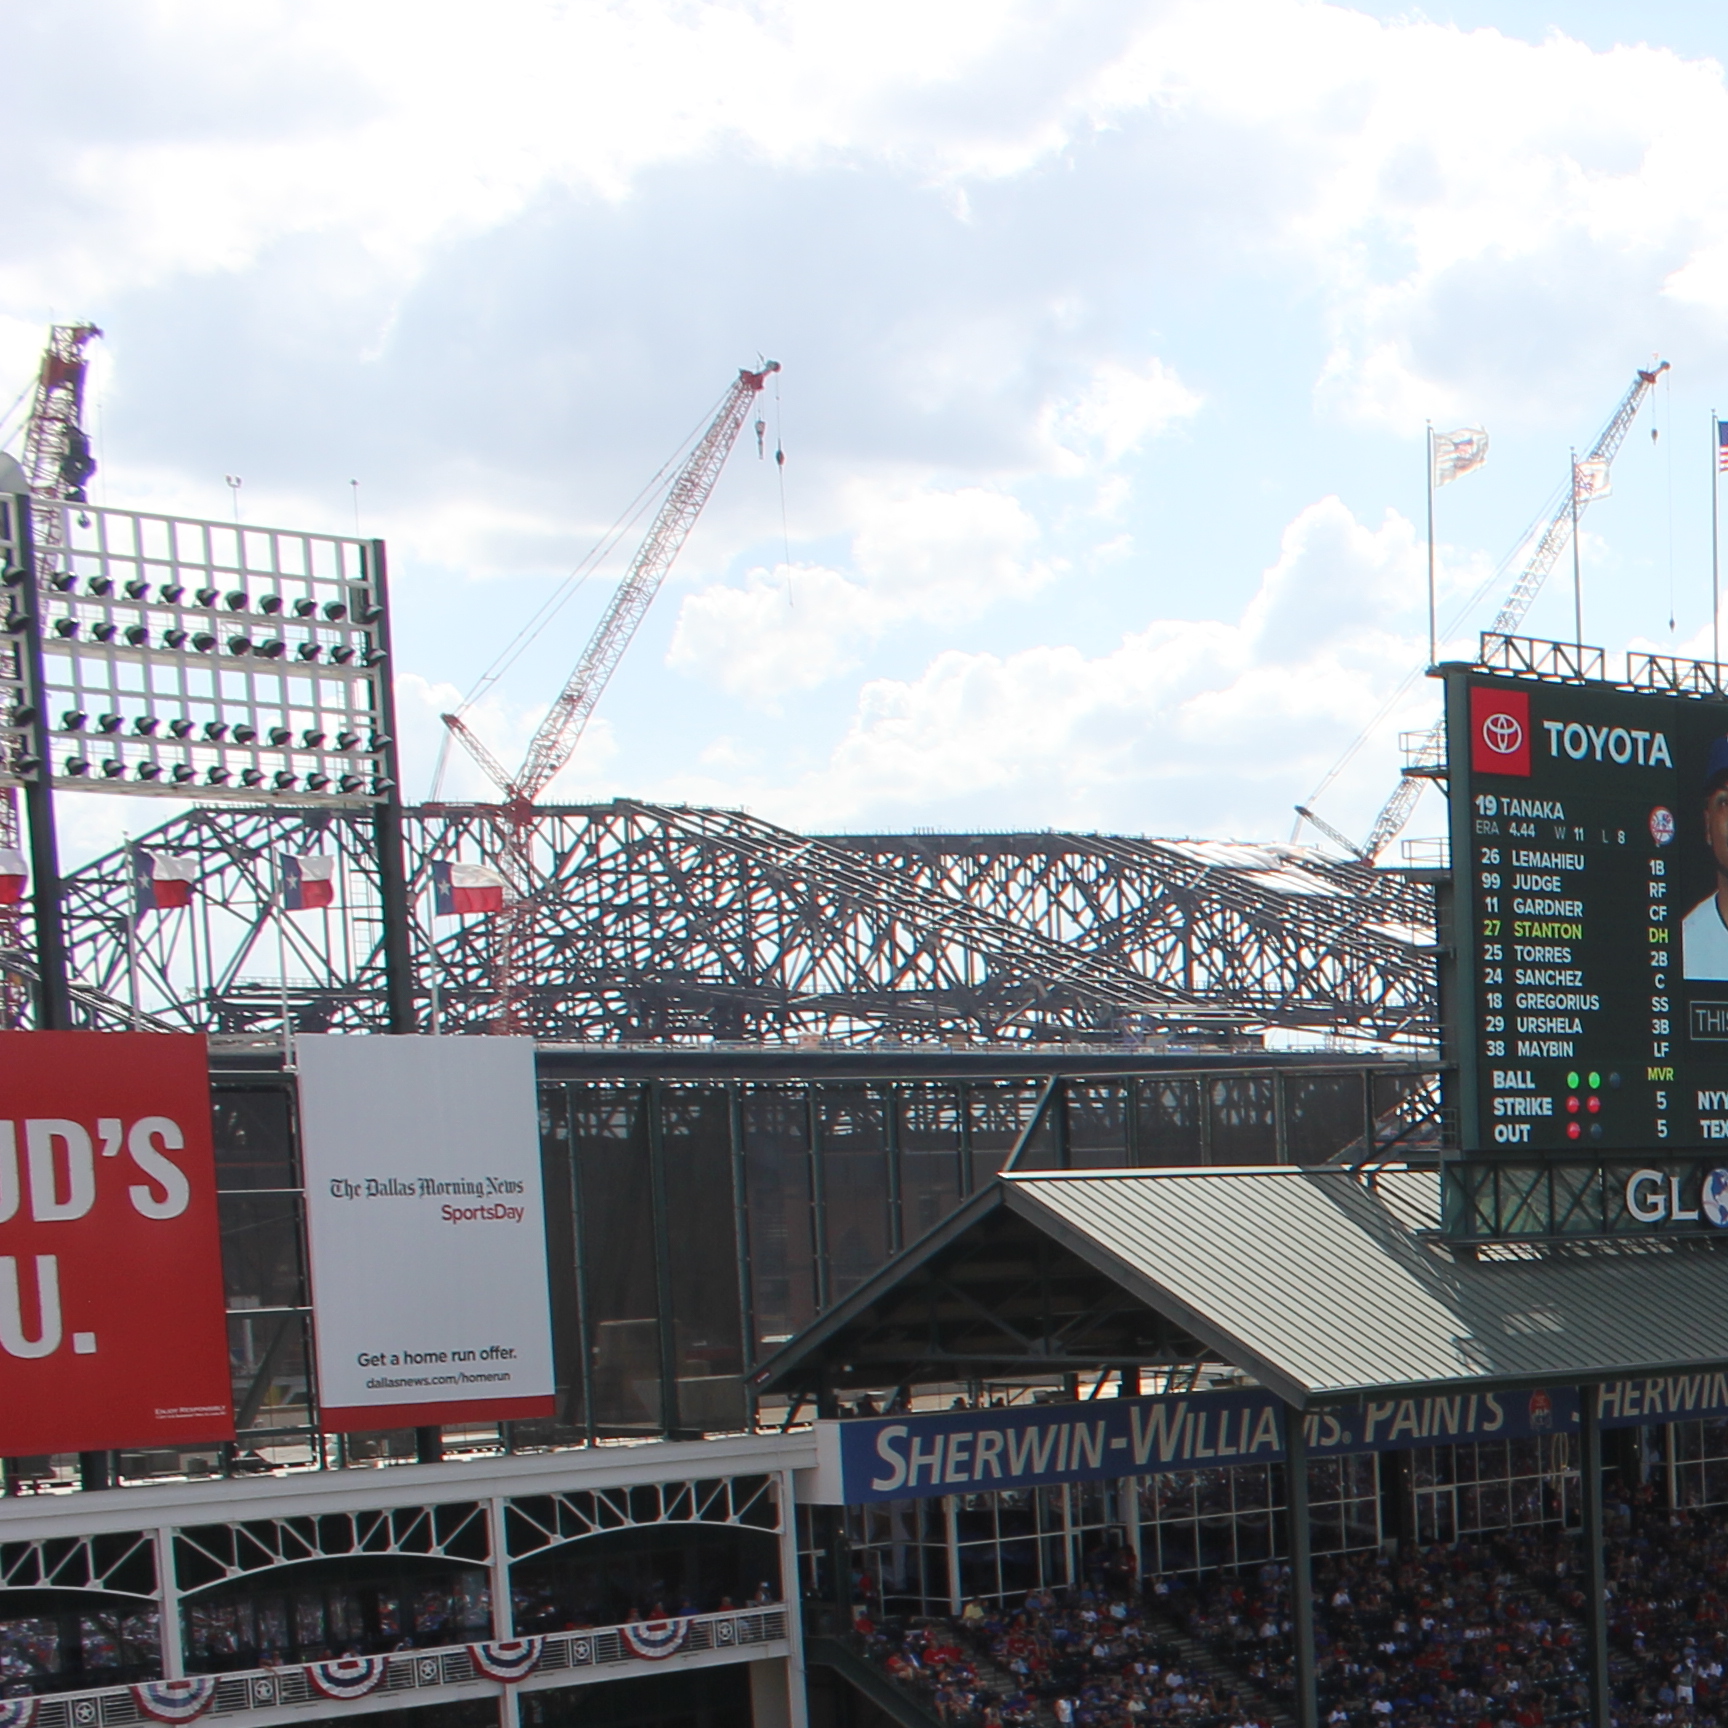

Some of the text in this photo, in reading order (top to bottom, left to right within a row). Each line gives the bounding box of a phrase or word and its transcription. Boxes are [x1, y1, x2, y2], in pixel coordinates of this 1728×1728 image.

[1543, 720, 1672, 768] TOYOTA
[1476, 795, 1563, 820] 19 TANAKA
[1476, 821, 1534, 837] ERA 4.44
[1482, 849, 1584, 871] 26 LEMAHIEU
[1482, 873, 1560, 892] 99 JUDGE
[1486, 897, 1582, 918] 11 GARDNER
[1484, 921, 1581, 939] 27 STANTON
[1484, 945, 1570, 962] 25 TORRES
[1484, 969, 1581, 987] 24 SANCHEZ
[1487, 993, 1598, 1010] 18 GREGORIUS
[1486, 1016, 1581, 1034] 29 URSHELA
[1486, 1041, 1572, 1058] 38 MAYBIN
[1493, 1071, 1534, 1089] BALL
[1648, 1068, 1673, 1081] MVR
[1493, 1098, 1551, 1116] STRIKE
[1494, 1124, 1529, 1142] OUT
[330, 1177, 523, 1199] The Dallas Morning News
[442, 1203, 523, 1224] SportsDay
[358, 1346, 516, 1368] Get a home run offer.
[366, 1370, 510, 1390] dallasnews.com/homerun
